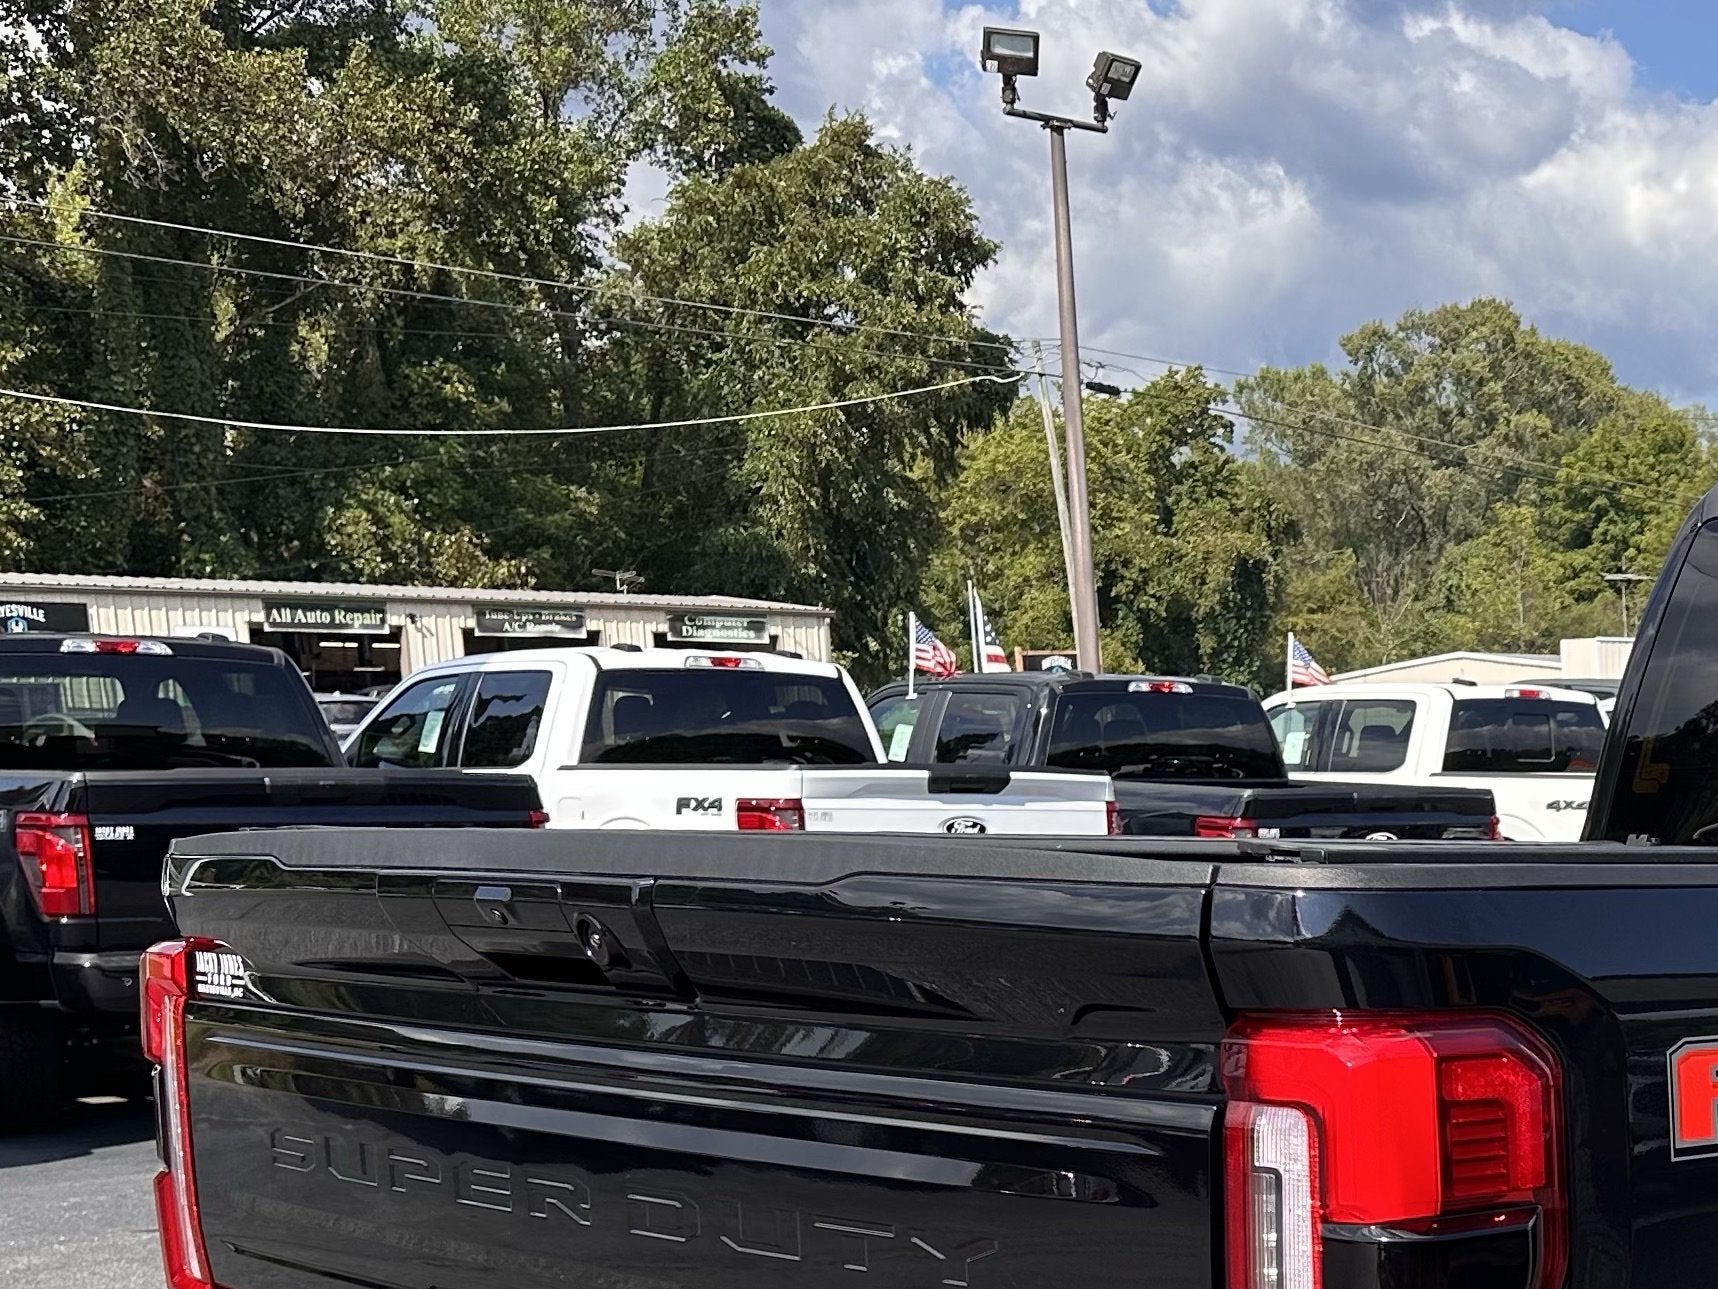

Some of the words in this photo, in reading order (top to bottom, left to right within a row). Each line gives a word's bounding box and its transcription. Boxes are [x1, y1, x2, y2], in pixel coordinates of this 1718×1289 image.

[269, 607, 291, 622] All
[294, 607, 331, 623] Auto
[334, 608, 383, 628] Repair
[681, 625, 756, 638] Diagnostics
[675, 796, 723, 815] FX4
[271, 1126, 592, 1227] SUPER
[626, 1185, 998, 1287] DUTY
